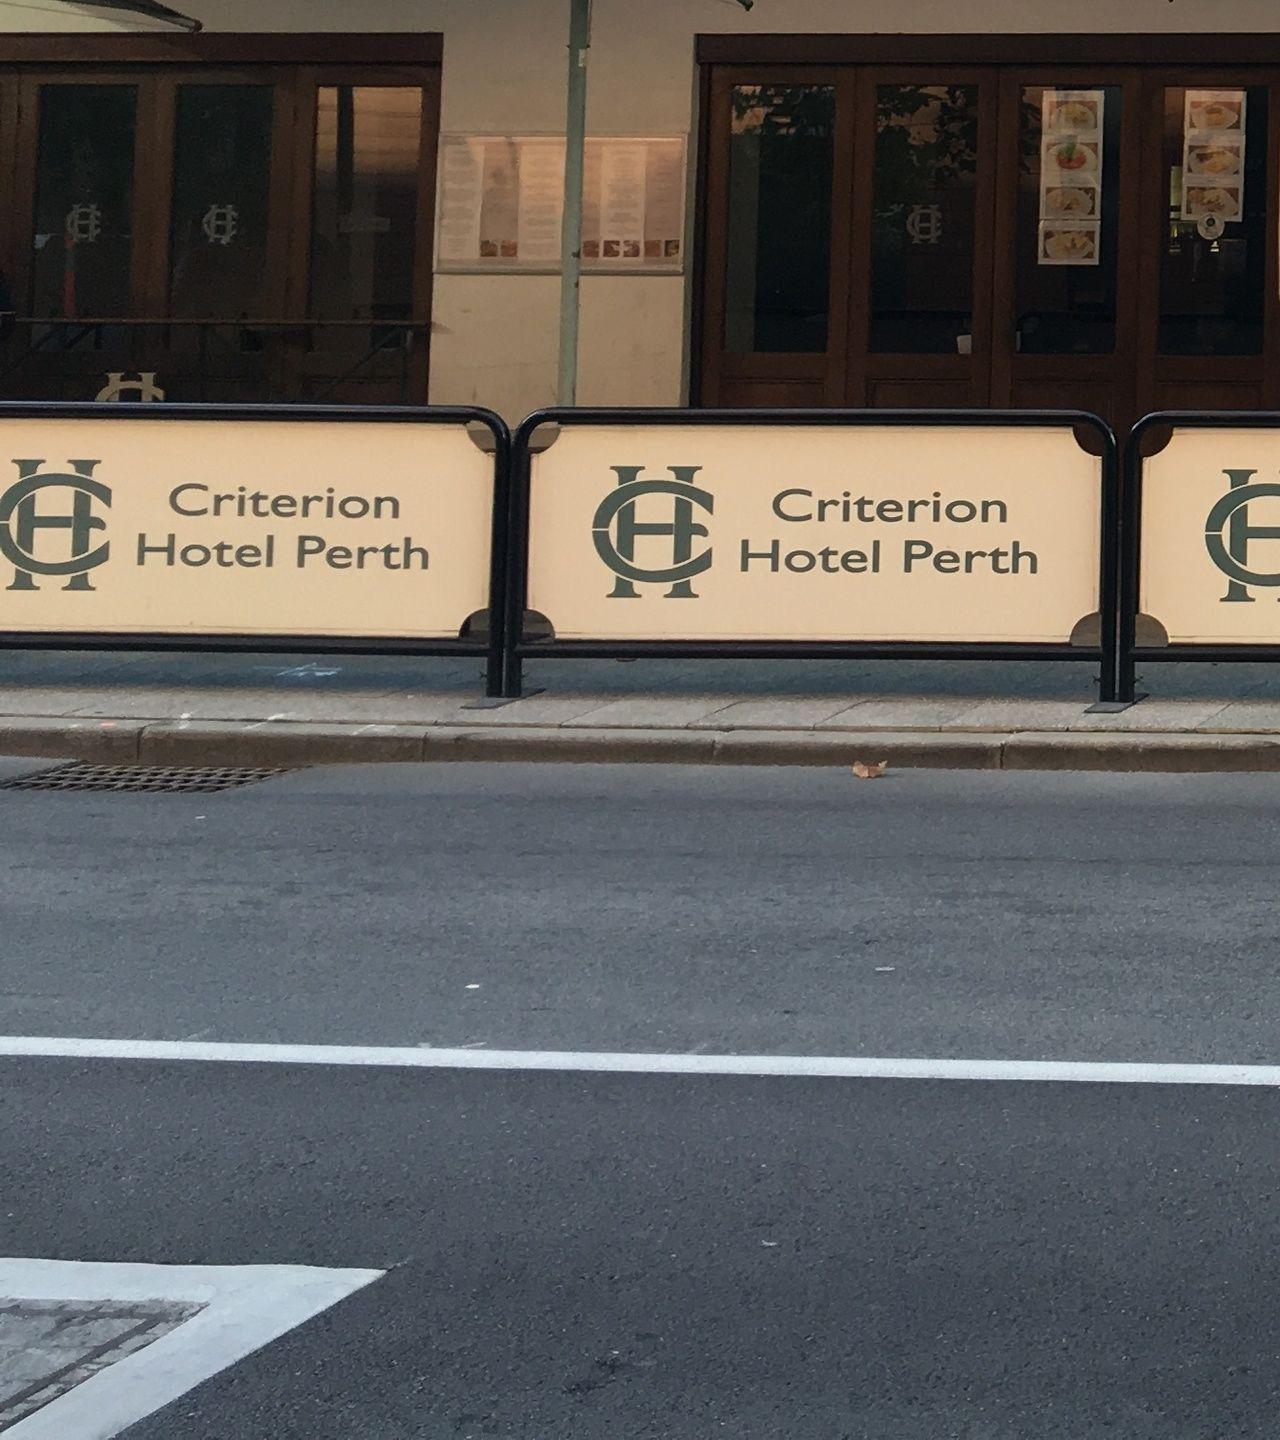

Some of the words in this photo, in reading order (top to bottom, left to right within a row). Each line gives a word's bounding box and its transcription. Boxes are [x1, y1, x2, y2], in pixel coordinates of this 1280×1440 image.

[169, 483, 400, 518] Criterion
[772, 488, 1008, 523] Criterion
[136, 533, 275, 567] Hotel
[296, 535, 429, 569] Perth
[740, 538, 881, 573] Hotel
[903, 540, 1038, 574] Perth
